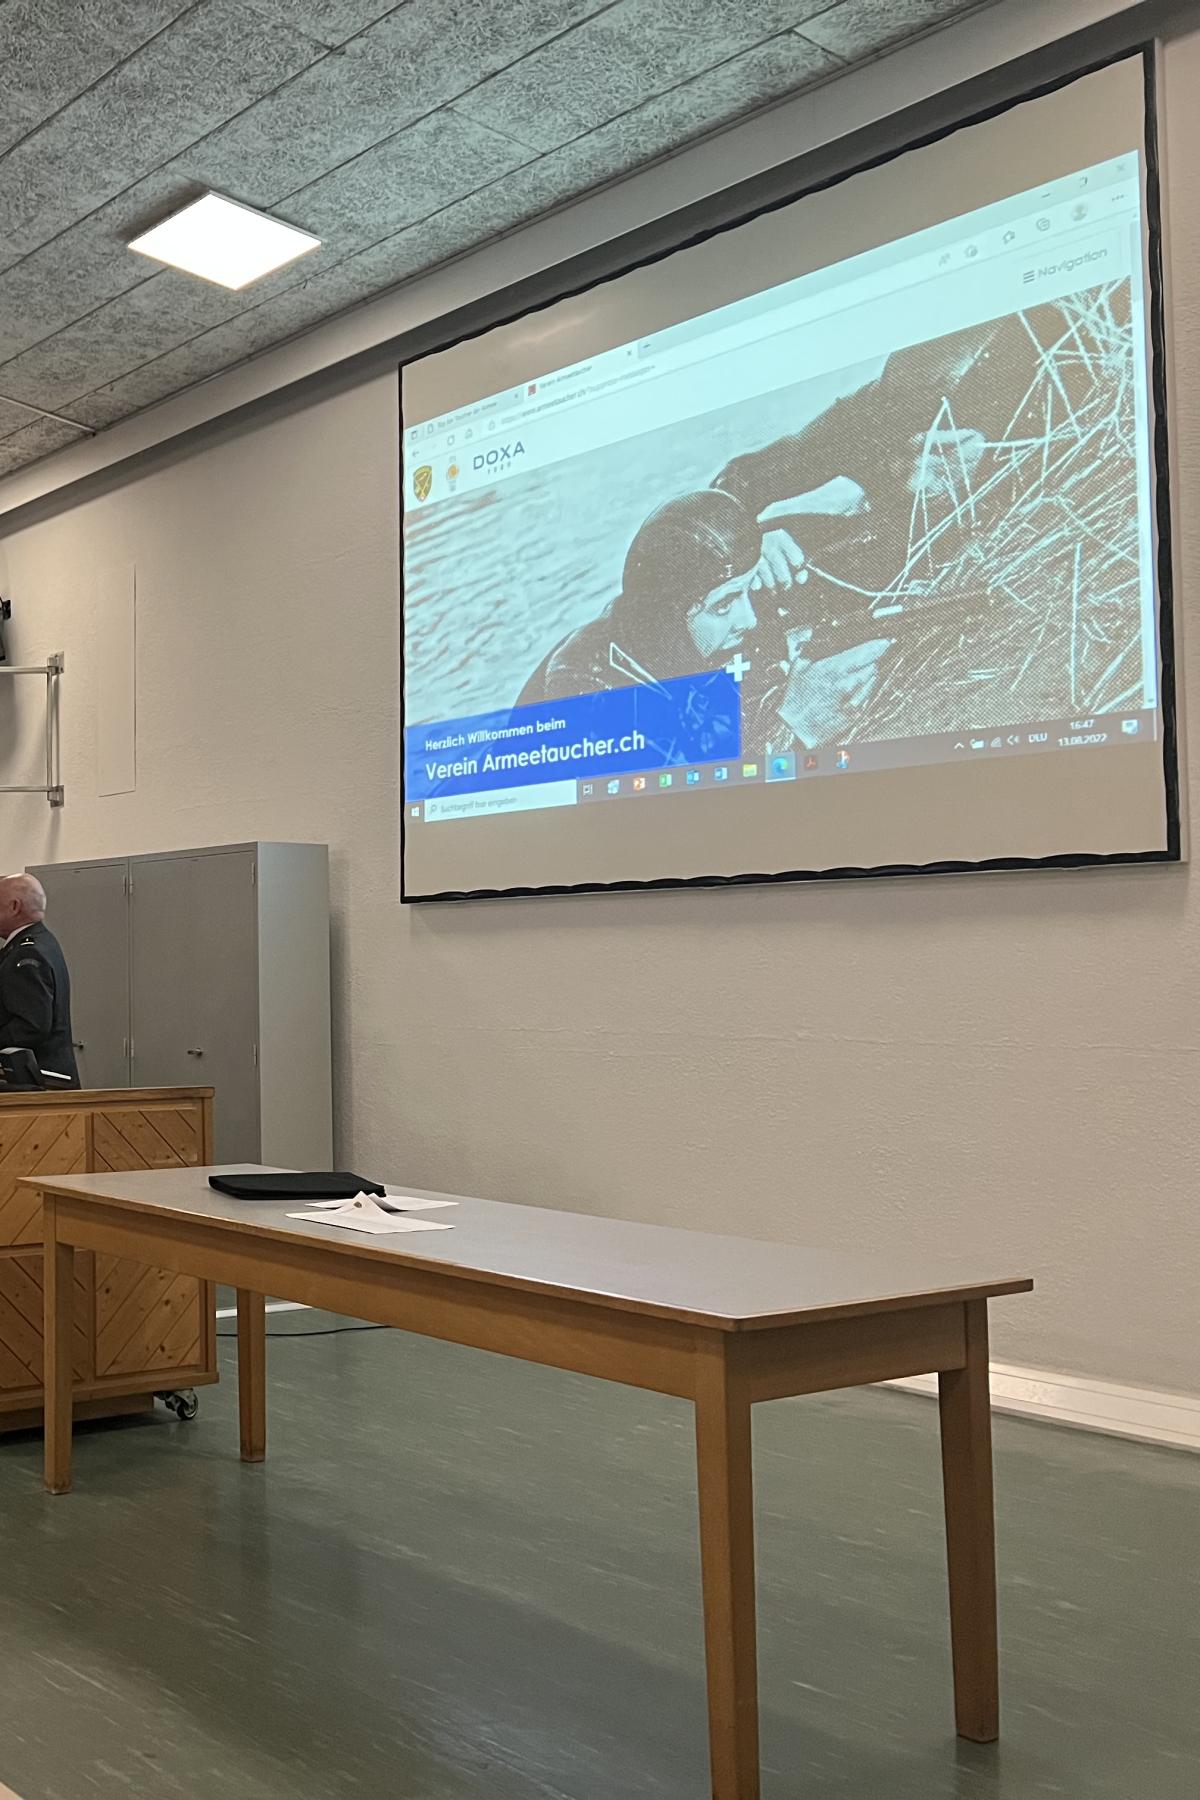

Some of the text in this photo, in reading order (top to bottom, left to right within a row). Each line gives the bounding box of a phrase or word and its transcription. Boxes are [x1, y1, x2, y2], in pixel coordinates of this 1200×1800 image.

[1038, 249, 1107, 278] Navigation
[473, 441, 525, 470] DOXA
[425, 717, 566, 752] Herzlich Willkommen beim
[425, 730, 646, 781] Verein Armeetaucher.ch
